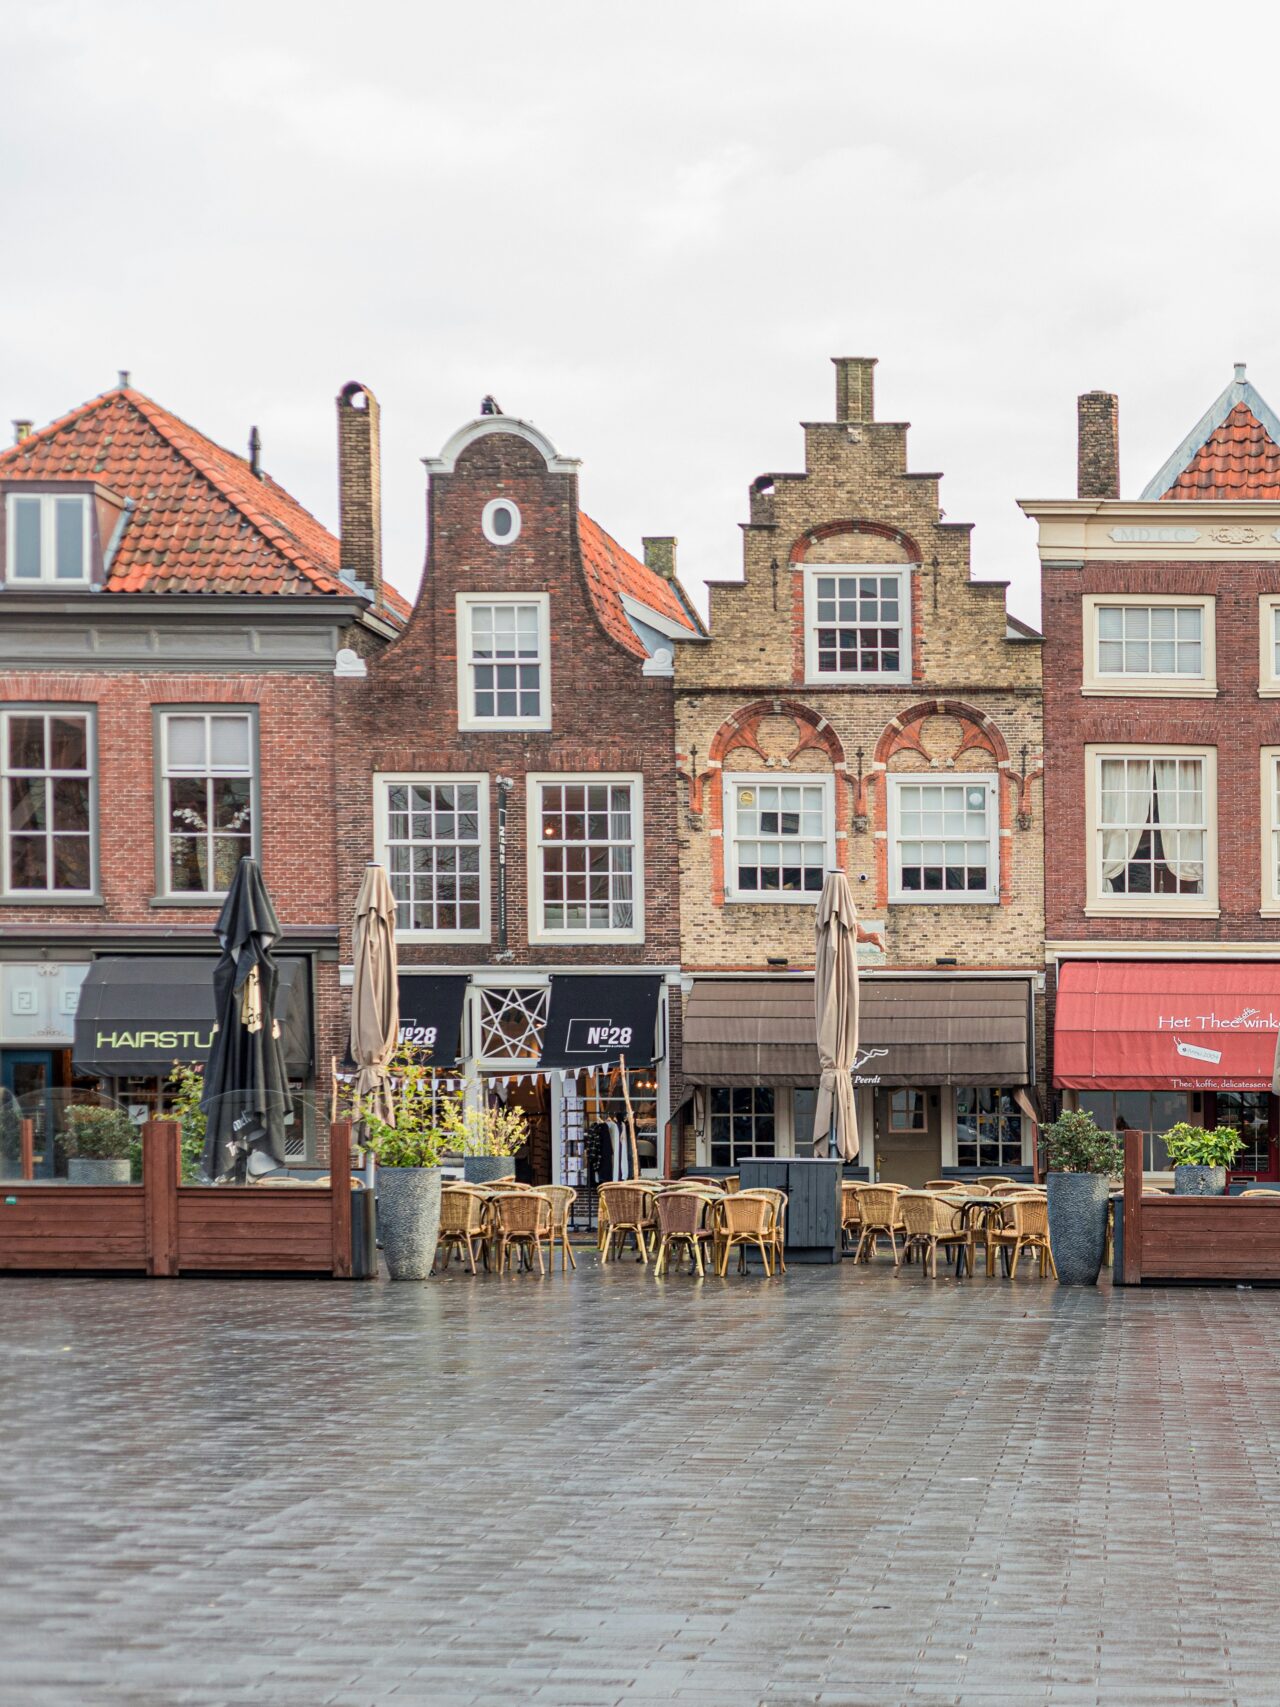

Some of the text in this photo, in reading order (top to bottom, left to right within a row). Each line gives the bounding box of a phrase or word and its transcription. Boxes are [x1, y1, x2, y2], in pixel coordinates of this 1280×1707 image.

[1158, 1015, 1191, 1029] Het
[96, 1031, 215, 1048] HAIRSTU
[854, 1074, 881, 1084] Peerdt
[1220, 1079, 1267, 1088] delicatessen
